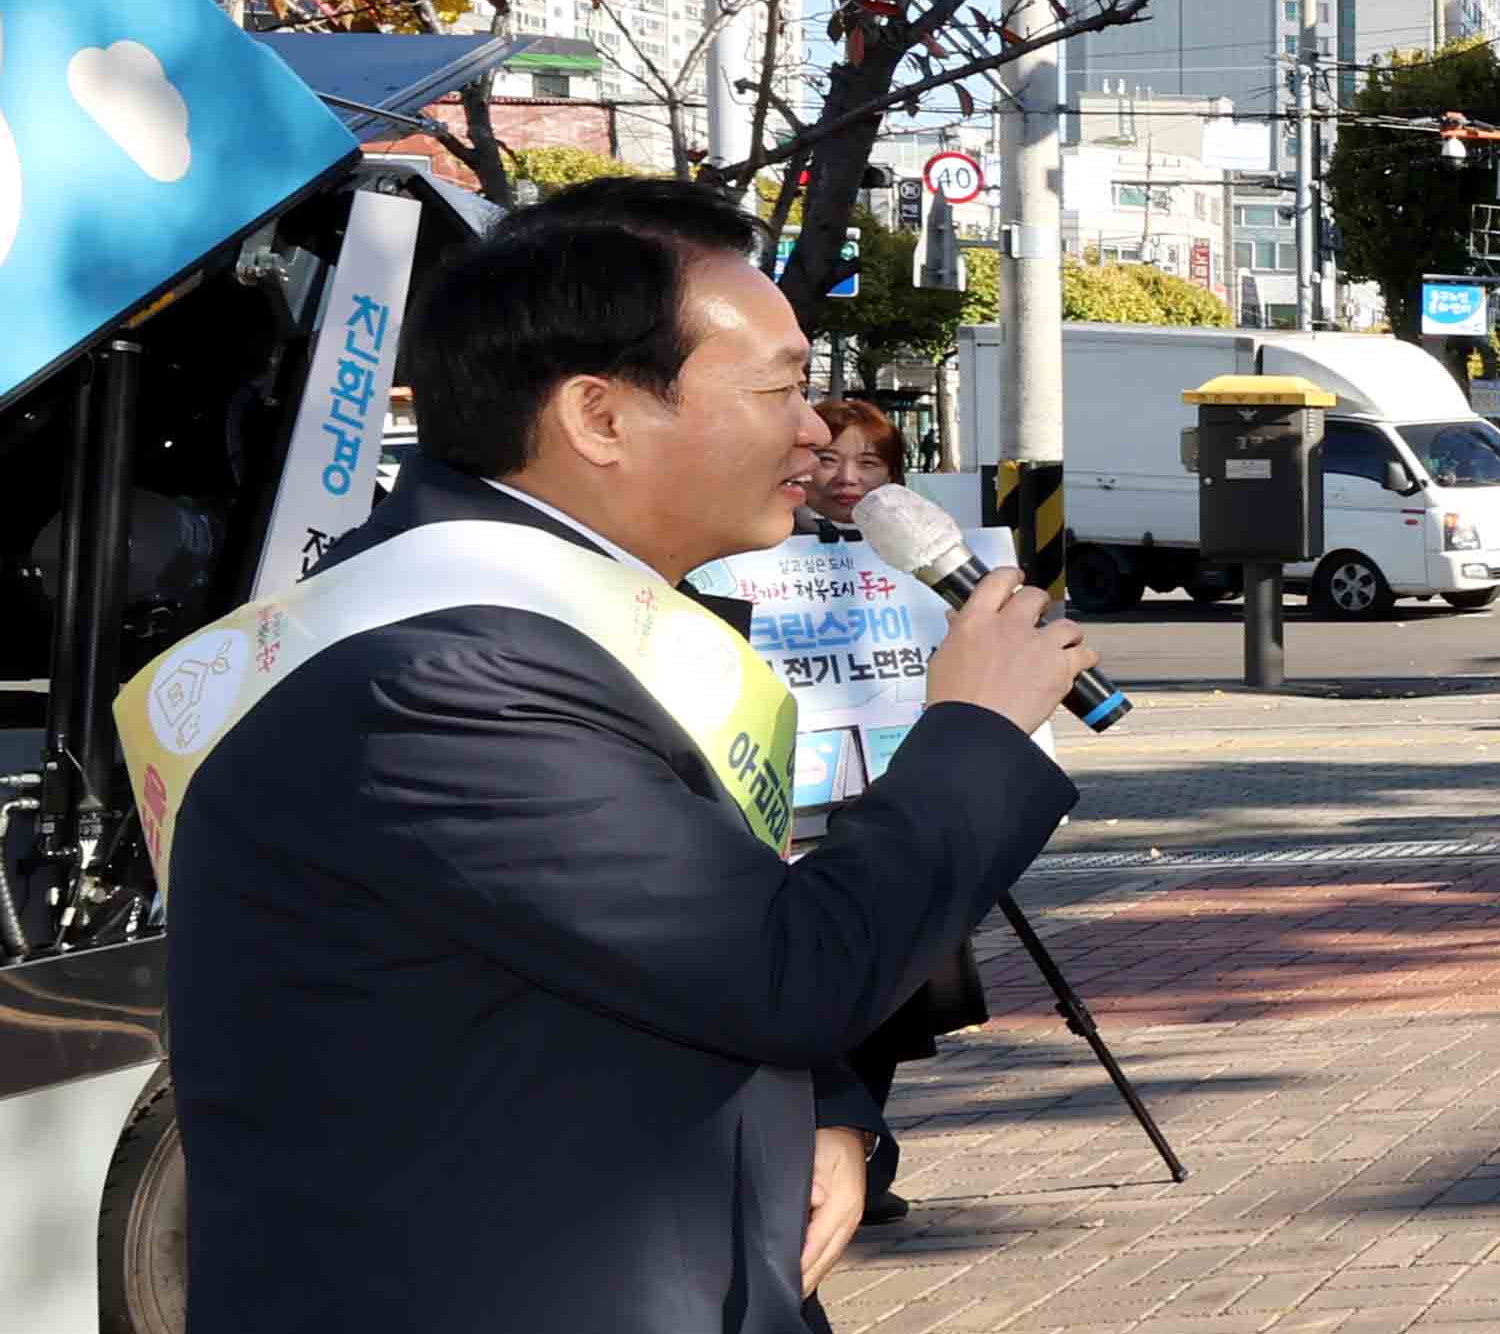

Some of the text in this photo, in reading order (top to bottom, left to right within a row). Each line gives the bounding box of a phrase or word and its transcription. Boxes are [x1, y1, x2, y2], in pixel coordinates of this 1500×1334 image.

[322, 293, 390, 496] 친환경
[858, 571, 897, 600] 동구
[784, 645, 938, 689] 전기 노면청
